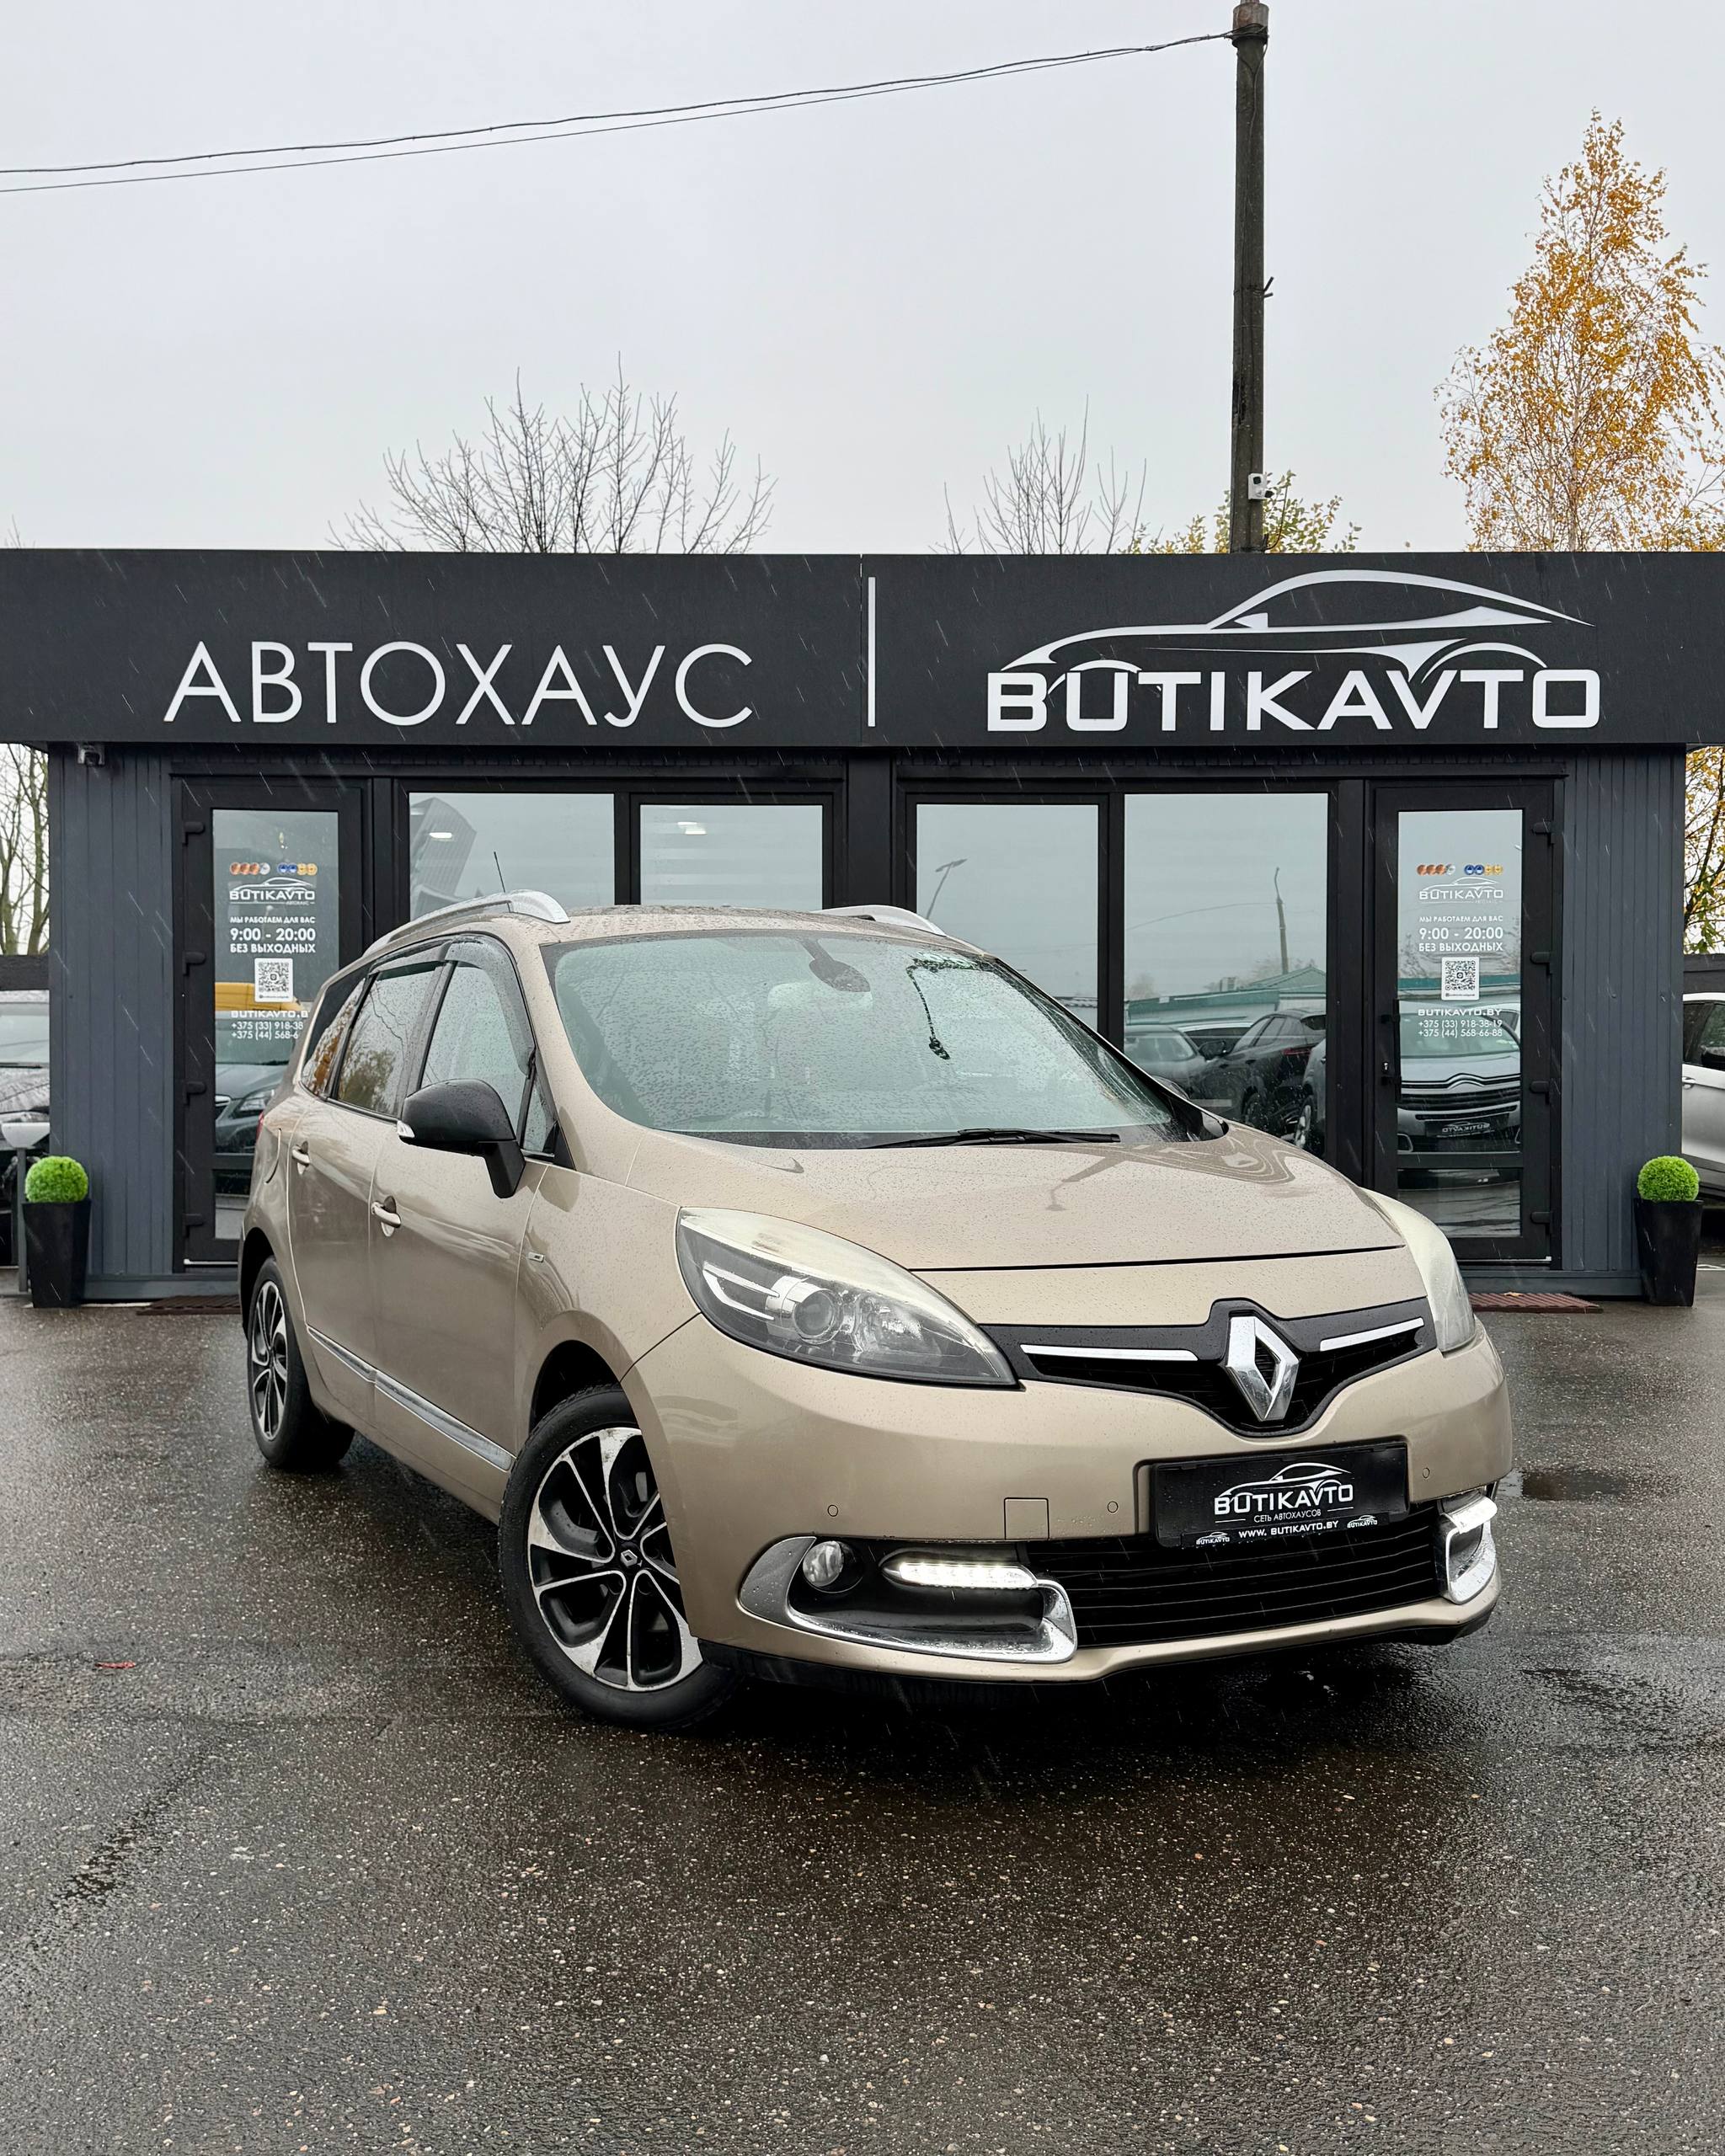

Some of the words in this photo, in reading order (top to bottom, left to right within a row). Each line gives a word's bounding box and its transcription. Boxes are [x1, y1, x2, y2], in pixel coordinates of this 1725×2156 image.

[163, 641, 754, 728] АВТОХАУС
[987, 669, 1600, 732] BUTIKAVTO
[229, 890, 315, 900] BUTIKAVTO
[1419, 890, 1503, 899] BUTIKAVTO
[230, 927, 261, 941] 9:00
[275, 927, 316, 941] 20:00
[1418, 927, 1449, 940] 9:00
[1464, 927, 1503, 940] 20:00
[230, 943, 248, 953] БЕЗ
[251, 943, 316, 954] ВЫХОДНЫХ
[1418, 943, 1436, 952] БЕЗ
[1439, 942, 1503, 953] ВЫХОДНЫХ
[231, 1022, 253, 1030] +375
[255, 1022, 271, 1031] (33)
[275, 1022, 304, 1030] 918-38
[1418, 1020, 1439, 1028] +375
[1441, 1020, 1458, 1029] (33)
[1461, 1020, 1503, 1028] 918-38-19
[231, 1031, 253, 1039] +375
[255, 1030, 272, 1040] (44)
[275, 1031, 299, 1039] 568-6
[1418, 1029, 1439, 1038] +375
[1441, 1029, 1458, 1038] (44)
[1461, 1029, 1503, 1038] 568-66-88
[1214, 1484, 1354, 1515] BUTIKAVTO
[1253, 1514, 1272, 1523] СЕТЬ
[1274, 1509, 1322, 1521] АВТОХАУСОВ
[1238, 1528, 1267, 1539] WWW.
[1270, 1520, 1339, 1535] BUTIKAVTO.BY
